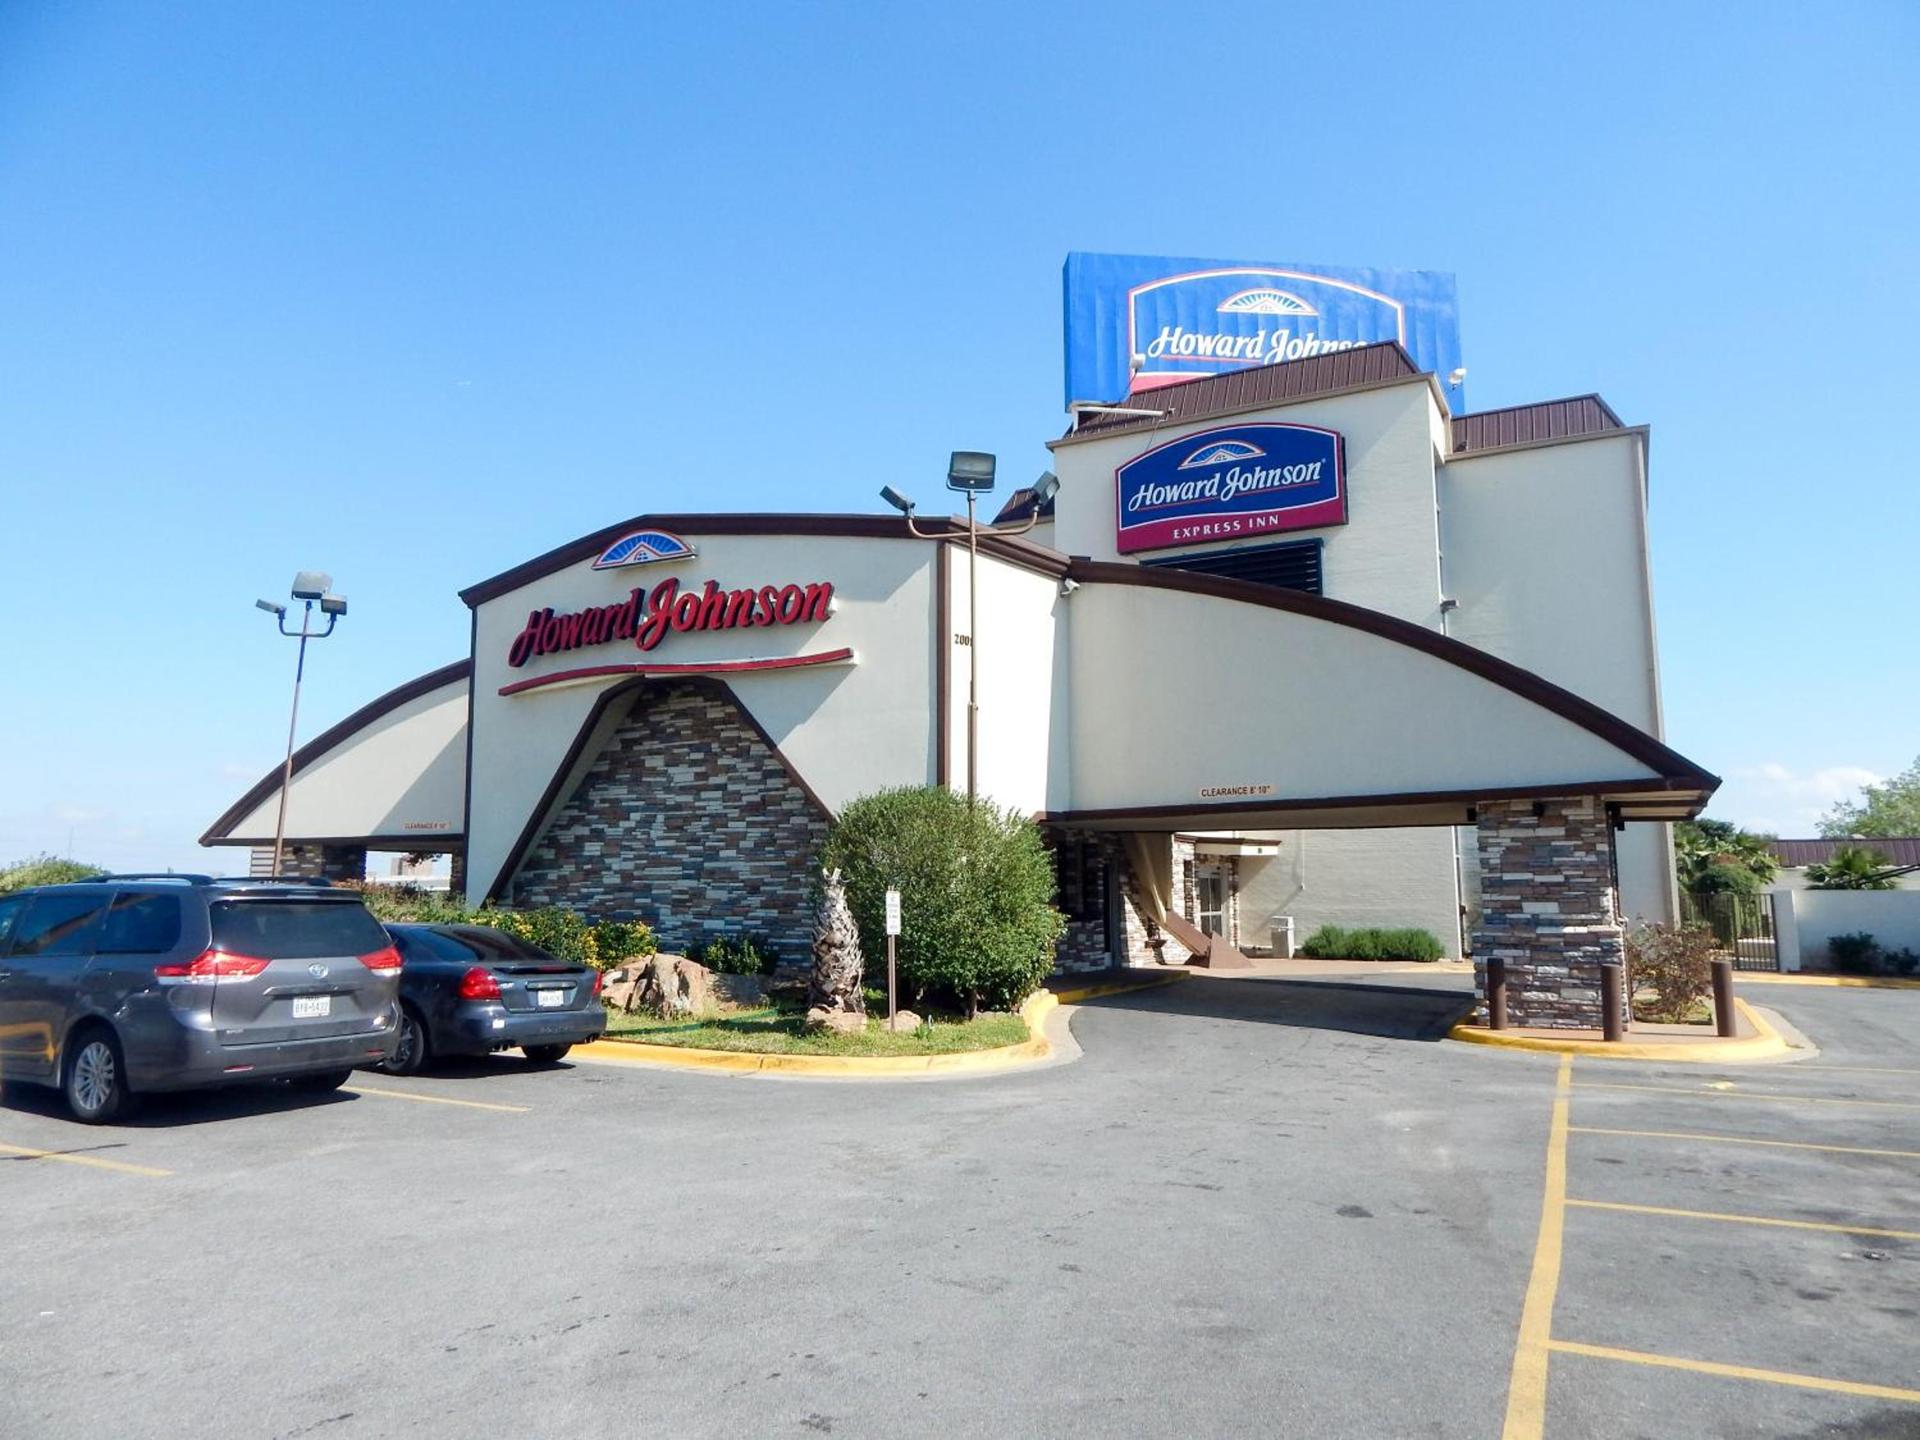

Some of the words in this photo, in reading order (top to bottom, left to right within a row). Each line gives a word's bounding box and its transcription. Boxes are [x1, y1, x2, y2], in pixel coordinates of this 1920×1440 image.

[1147, 326, 1266, 358] Howard
[1128, 472, 1221, 512] Howard
[1220, 463, 1321, 501] Johnson
[1173, 520, 1241, 539] EXPRESS
[1249, 514, 1279, 528] INN
[508, 587, 646, 668] Howard
[634, 576, 835, 652] Johnson
[1201, 786, 1248, 797] CLEARANCE
